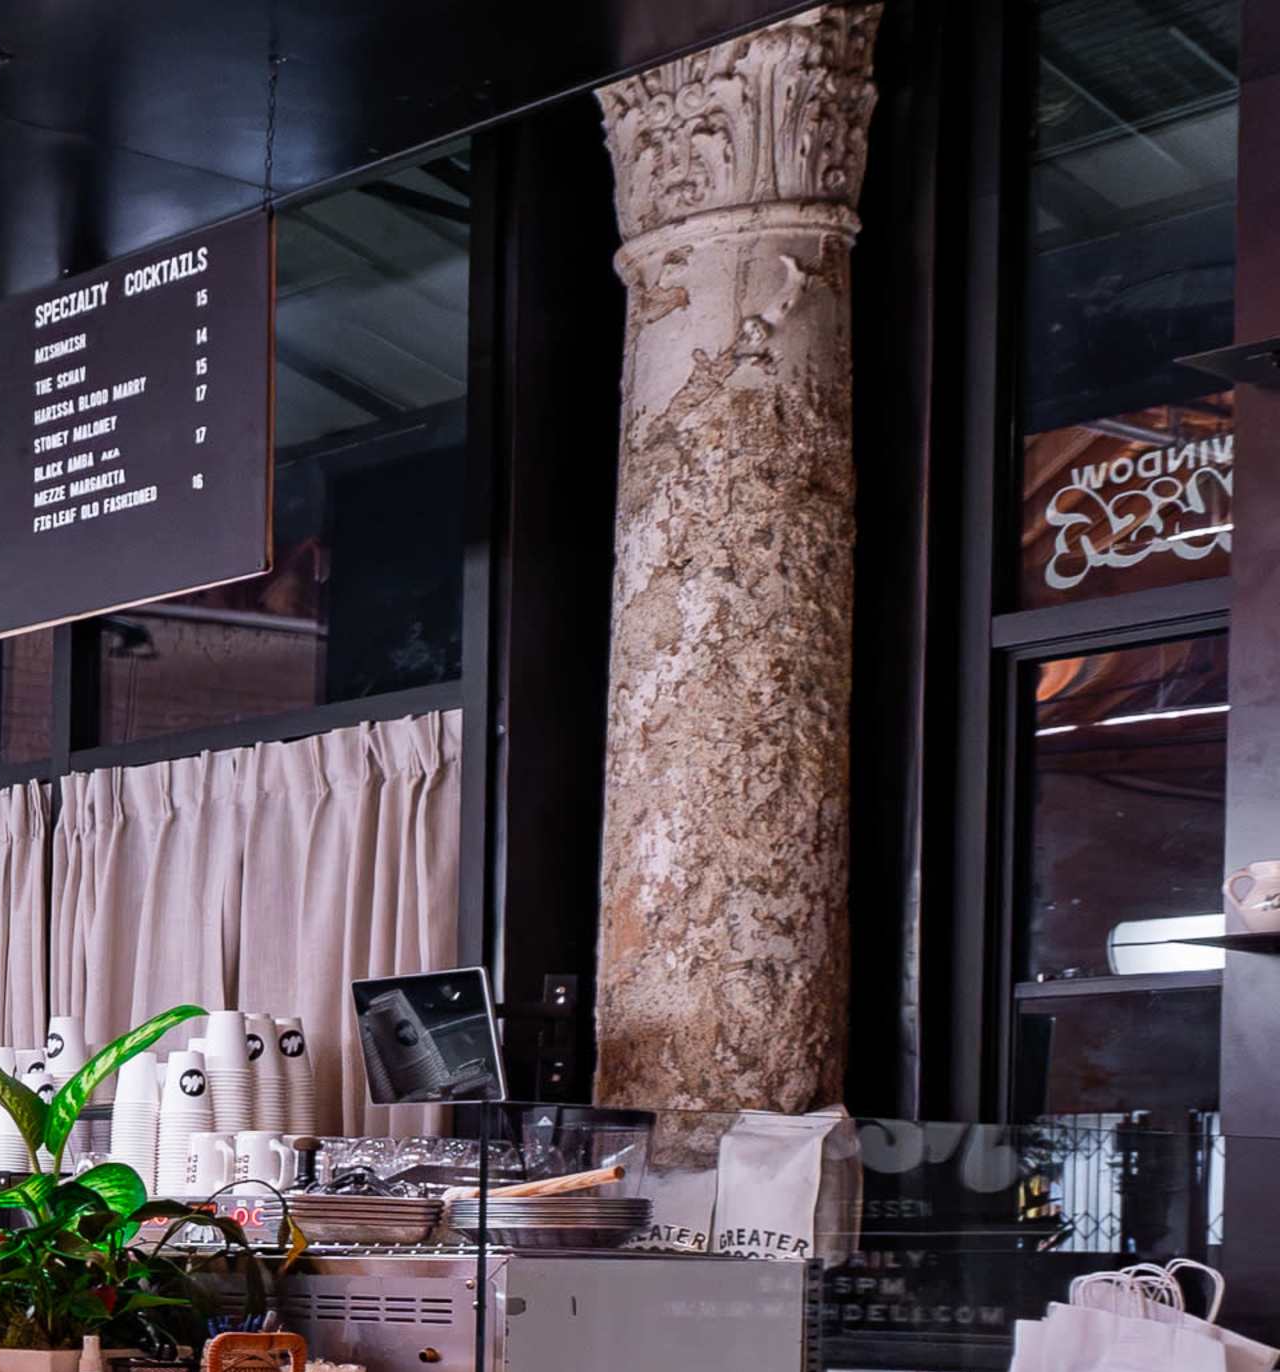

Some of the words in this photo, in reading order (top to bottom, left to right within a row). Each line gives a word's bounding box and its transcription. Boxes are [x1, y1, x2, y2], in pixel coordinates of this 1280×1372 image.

[35, 281, 109, 328] SPECIALTY
[124, 246, 208, 296] COCKTAILS
[34, 333, 87, 364] MISHMISH
[196, 289, 208, 307] 15
[34, 399, 75, 425] HARISSA
[78, 388, 109, 412] BLOOD
[112, 376, 146, 401] MARRY
[196, 357, 207, 375] 15
[35, 377, 53, 395] THE
[196, 327, 208, 345] 14
[34, 430, 70, 454] STONEY
[72, 415, 117, 442] MALONEY
[196, 384, 207, 402] 17
[34, 460, 63, 483] BLACK
[67, 452, 94, 473] AMBA
[195, 426, 207, 444] 17
[34, 485, 66, 508] MEZZE
[69, 468, 125, 498] MARGARITA
[80, 501, 99, 520] OLD
[103, 485, 158, 514] FASHIONED
[192, 473, 204, 489] 16
[719, 1227, 810, 1258] GREATER
